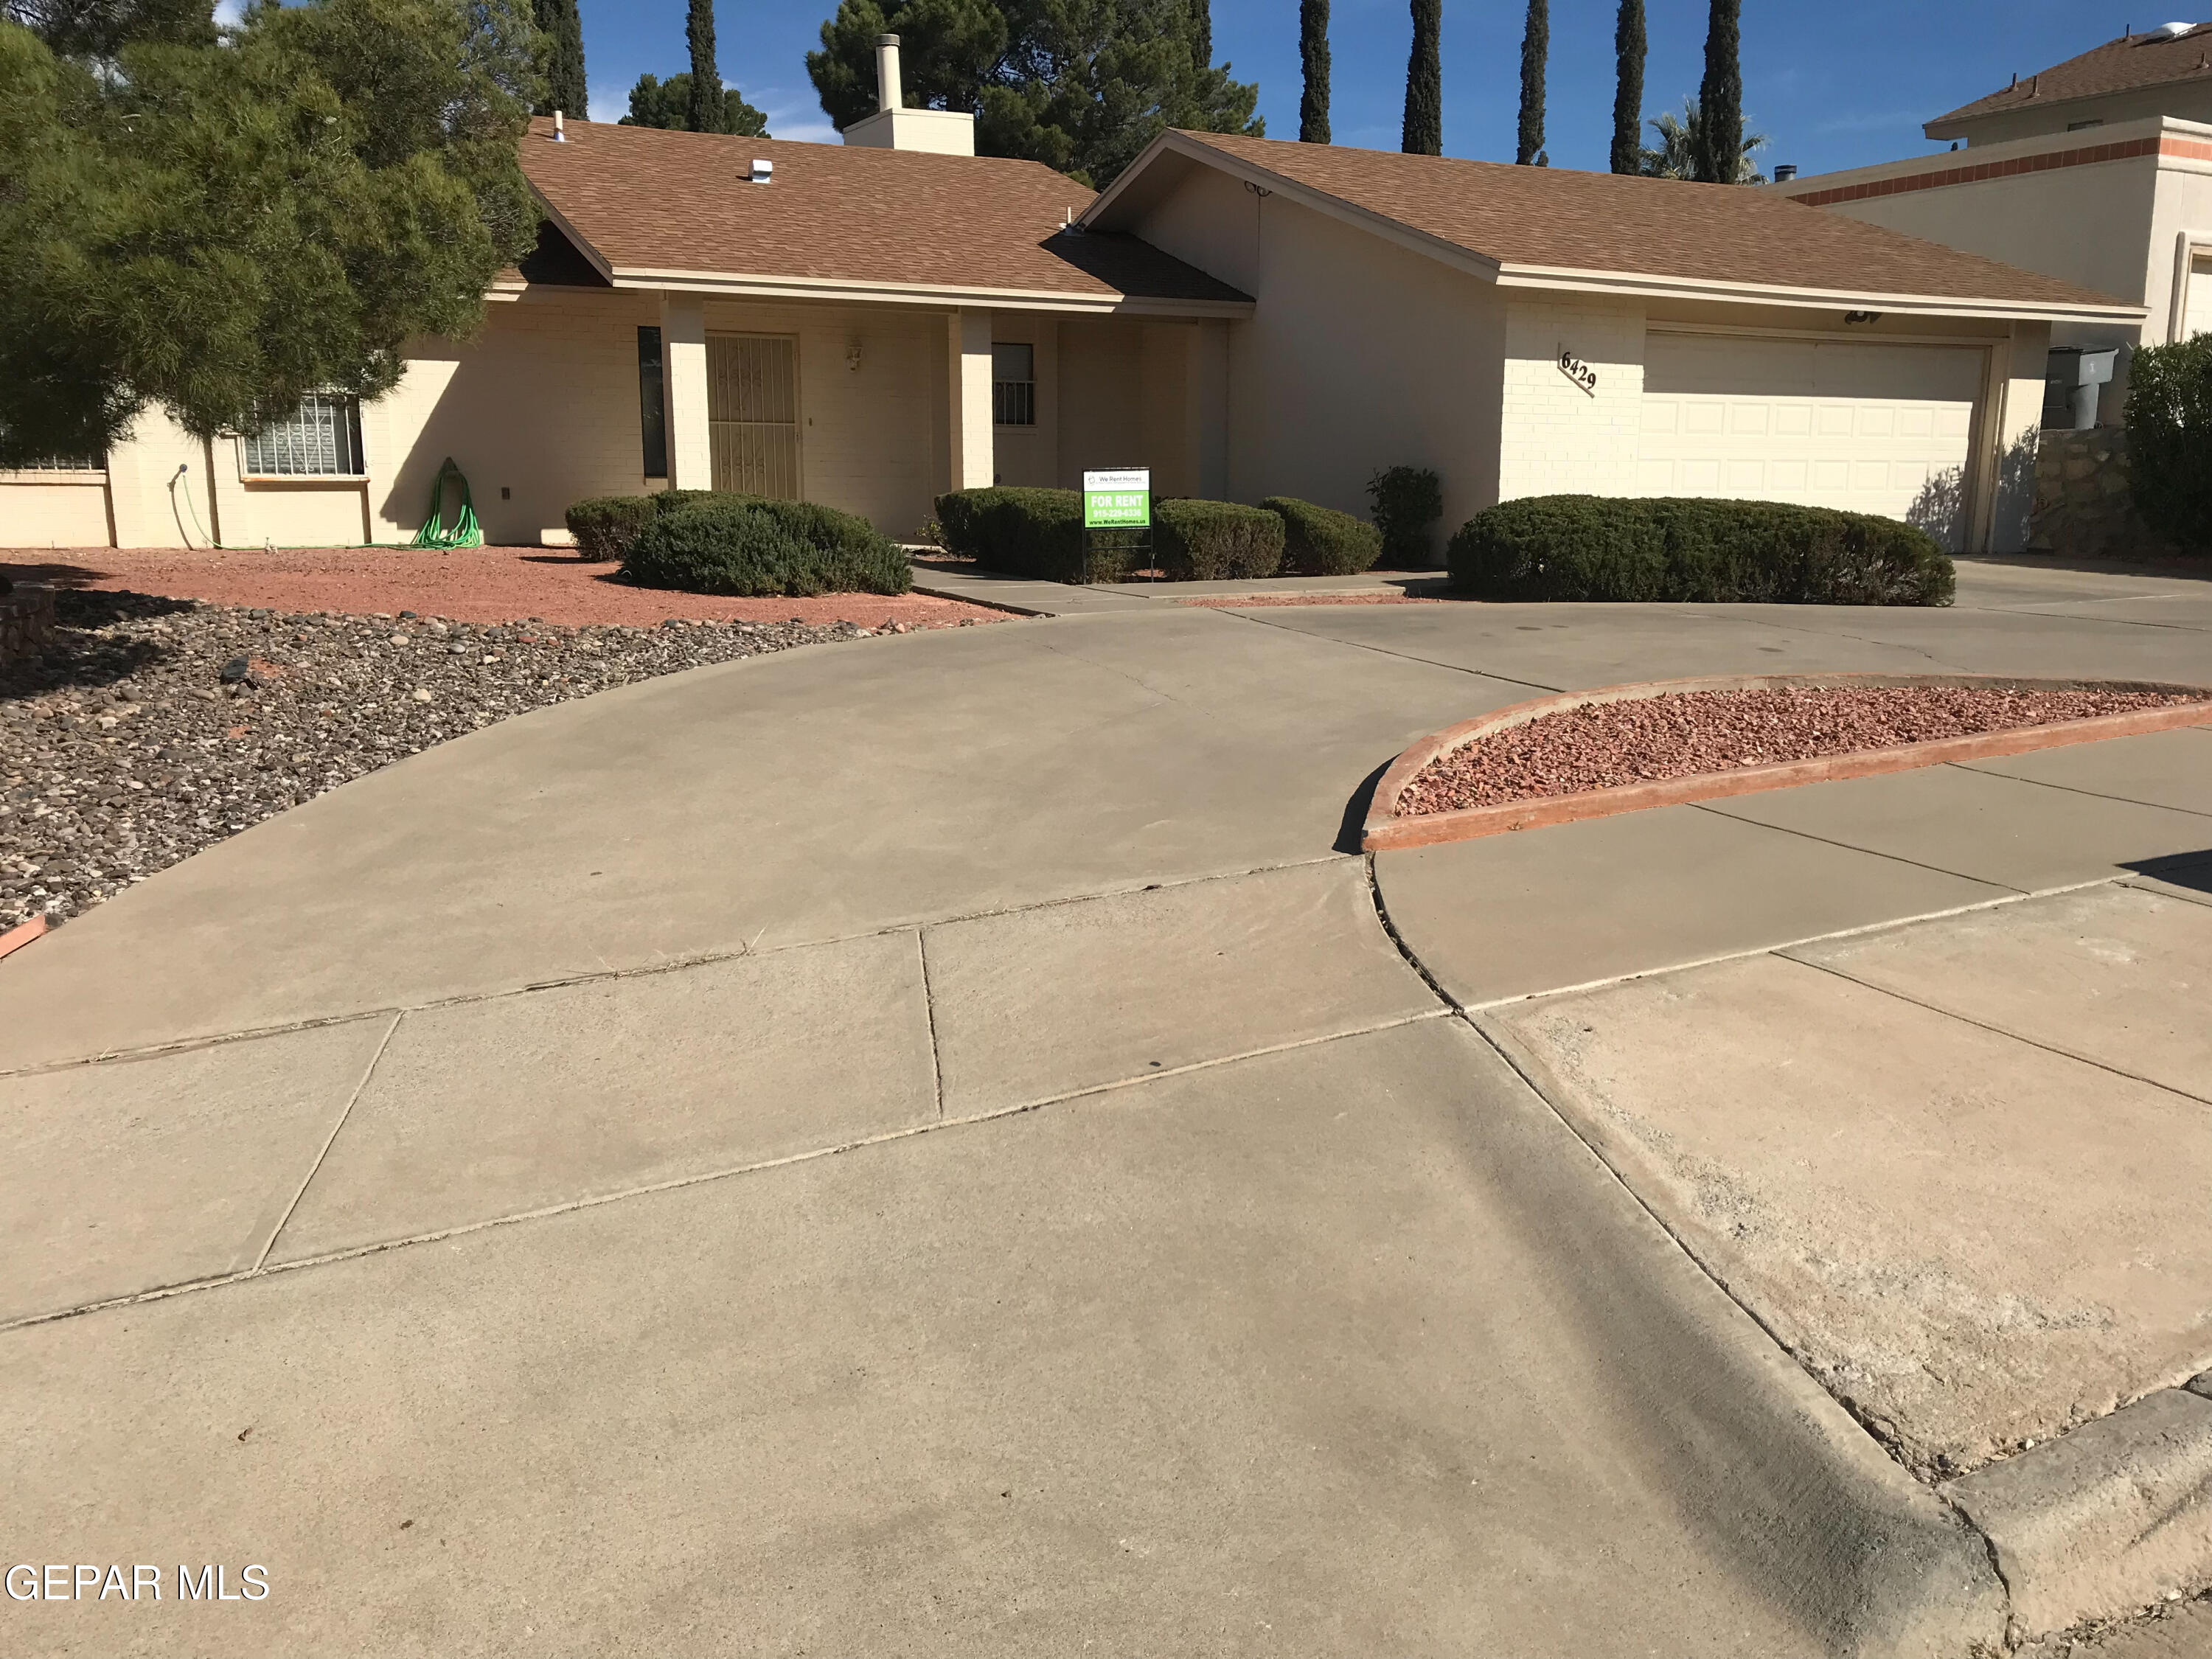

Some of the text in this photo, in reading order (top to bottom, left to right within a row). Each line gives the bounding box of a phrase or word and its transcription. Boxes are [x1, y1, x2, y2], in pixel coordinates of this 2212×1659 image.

[1562, 351, 1596, 389] 6429
[1091, 495, 1143, 507] FOR RENT
